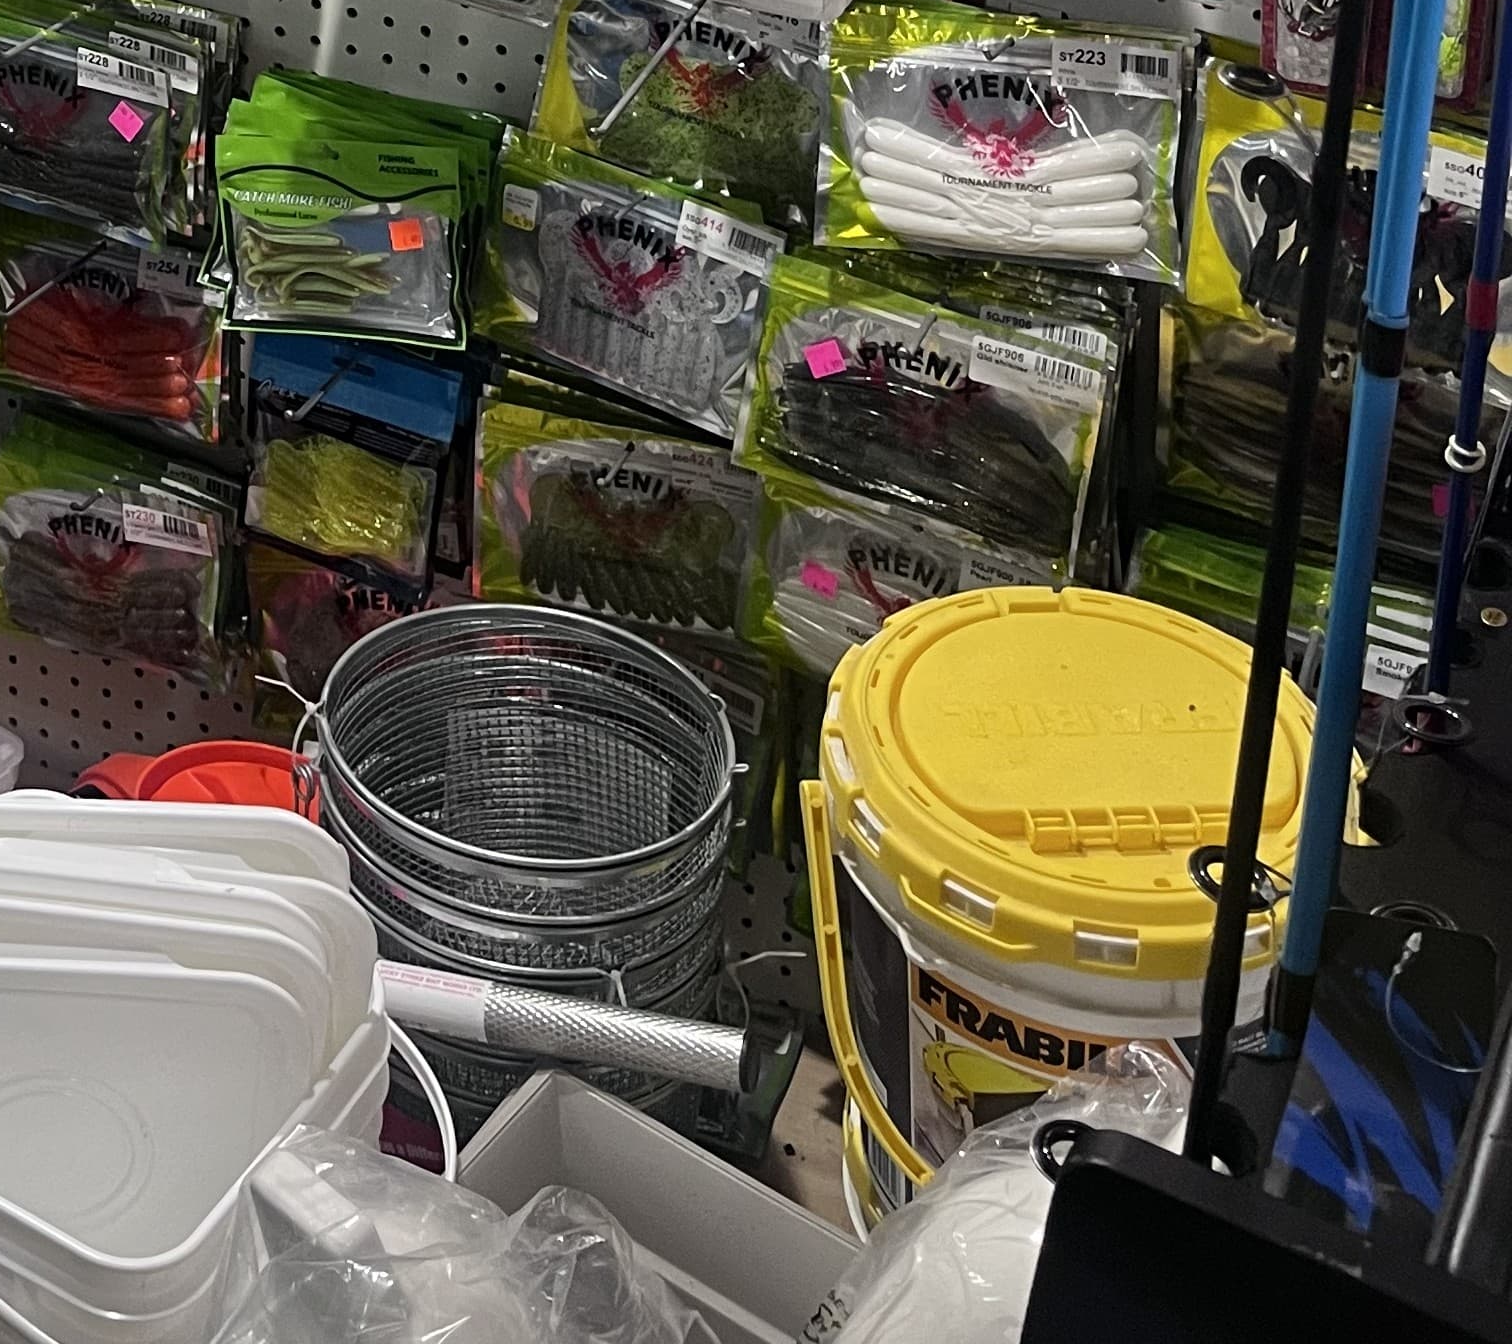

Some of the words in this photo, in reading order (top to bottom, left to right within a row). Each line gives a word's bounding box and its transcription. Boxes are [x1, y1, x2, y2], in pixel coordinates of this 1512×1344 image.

[1059, 48, 1106, 66] ST223
[941, 174, 1013, 192] TOURNAMENT
[1016, 180, 1053, 195] TACKLE
[235, 190, 278, 202] CATCH
[279, 194, 315, 206] MORE
